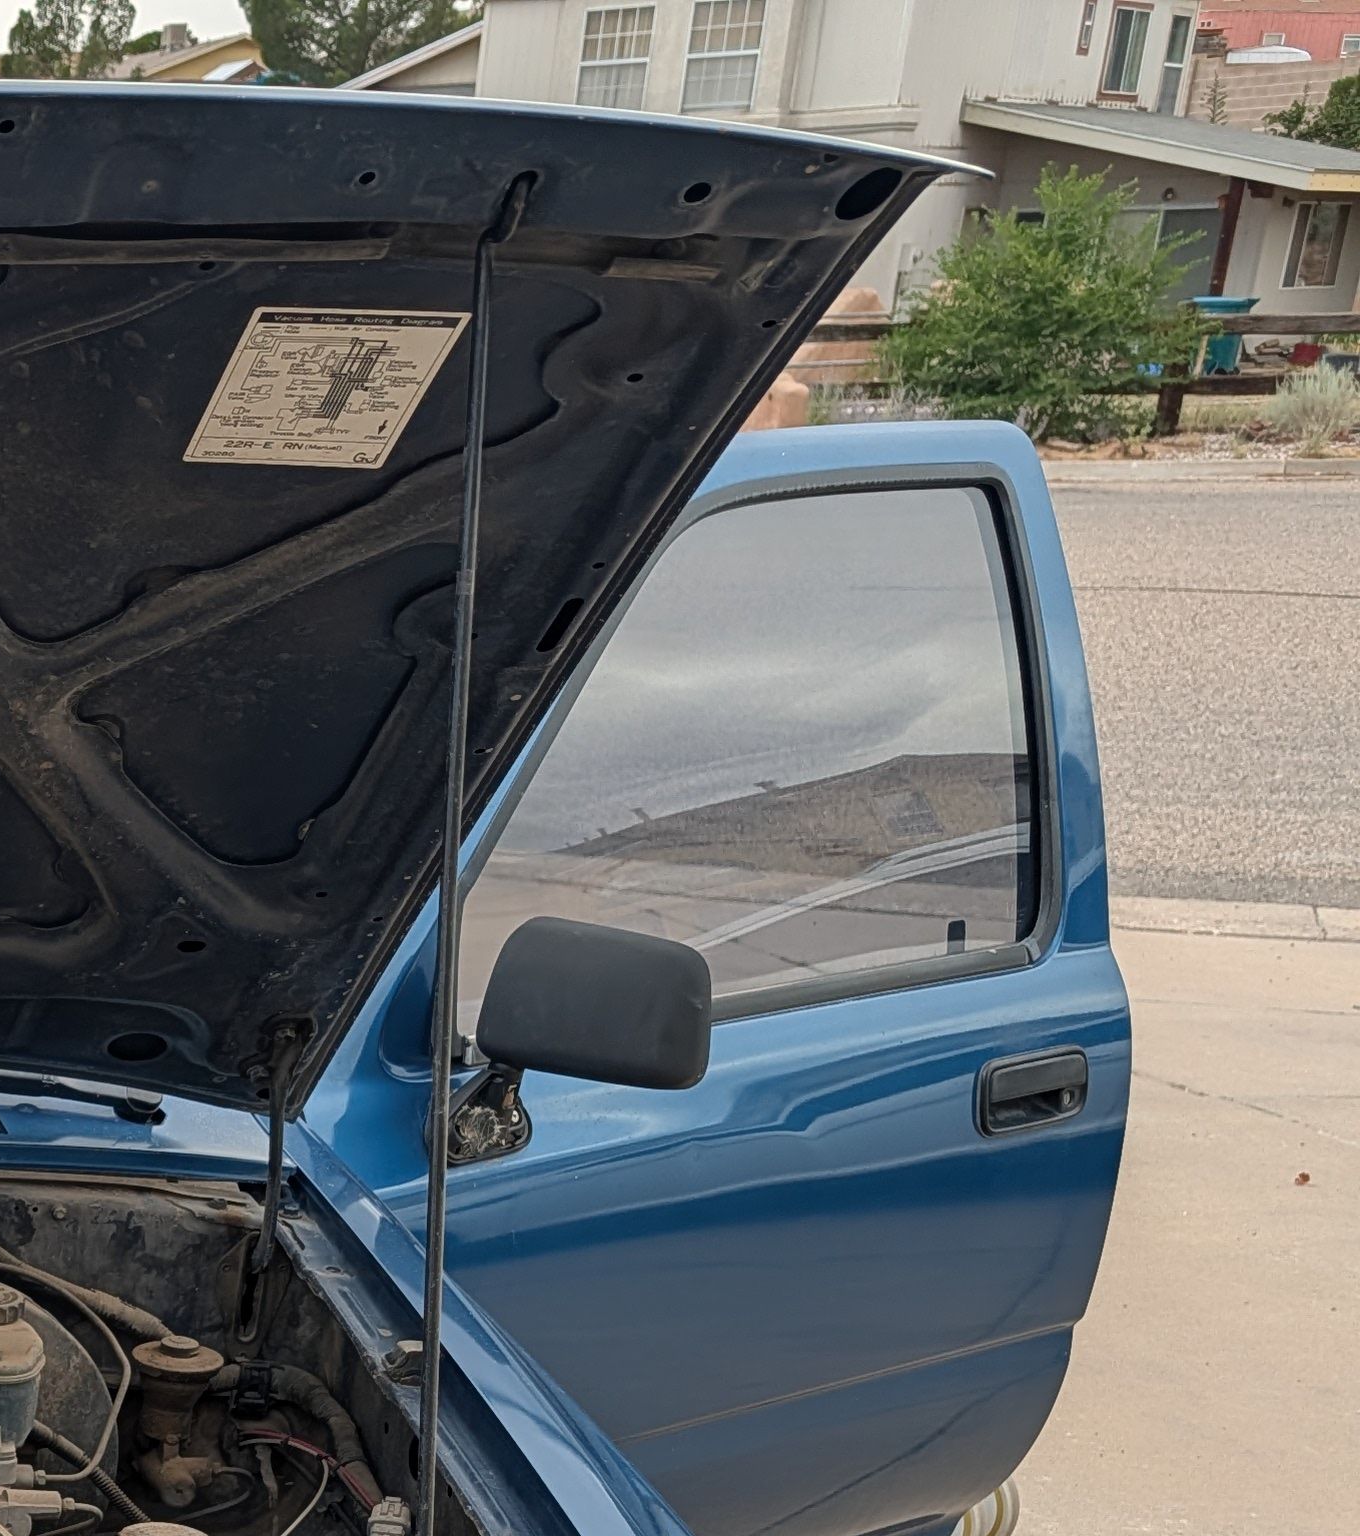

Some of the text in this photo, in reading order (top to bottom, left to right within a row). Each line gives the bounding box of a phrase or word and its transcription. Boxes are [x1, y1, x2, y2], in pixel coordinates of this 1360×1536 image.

[273, 314, 314, 322] Vacuum
[353, 316, 395, 325] Routing
[400, 317, 444, 326] Diagram
[223, 440, 275, 450] 22R-E
[283, 442, 304, 450] RN
